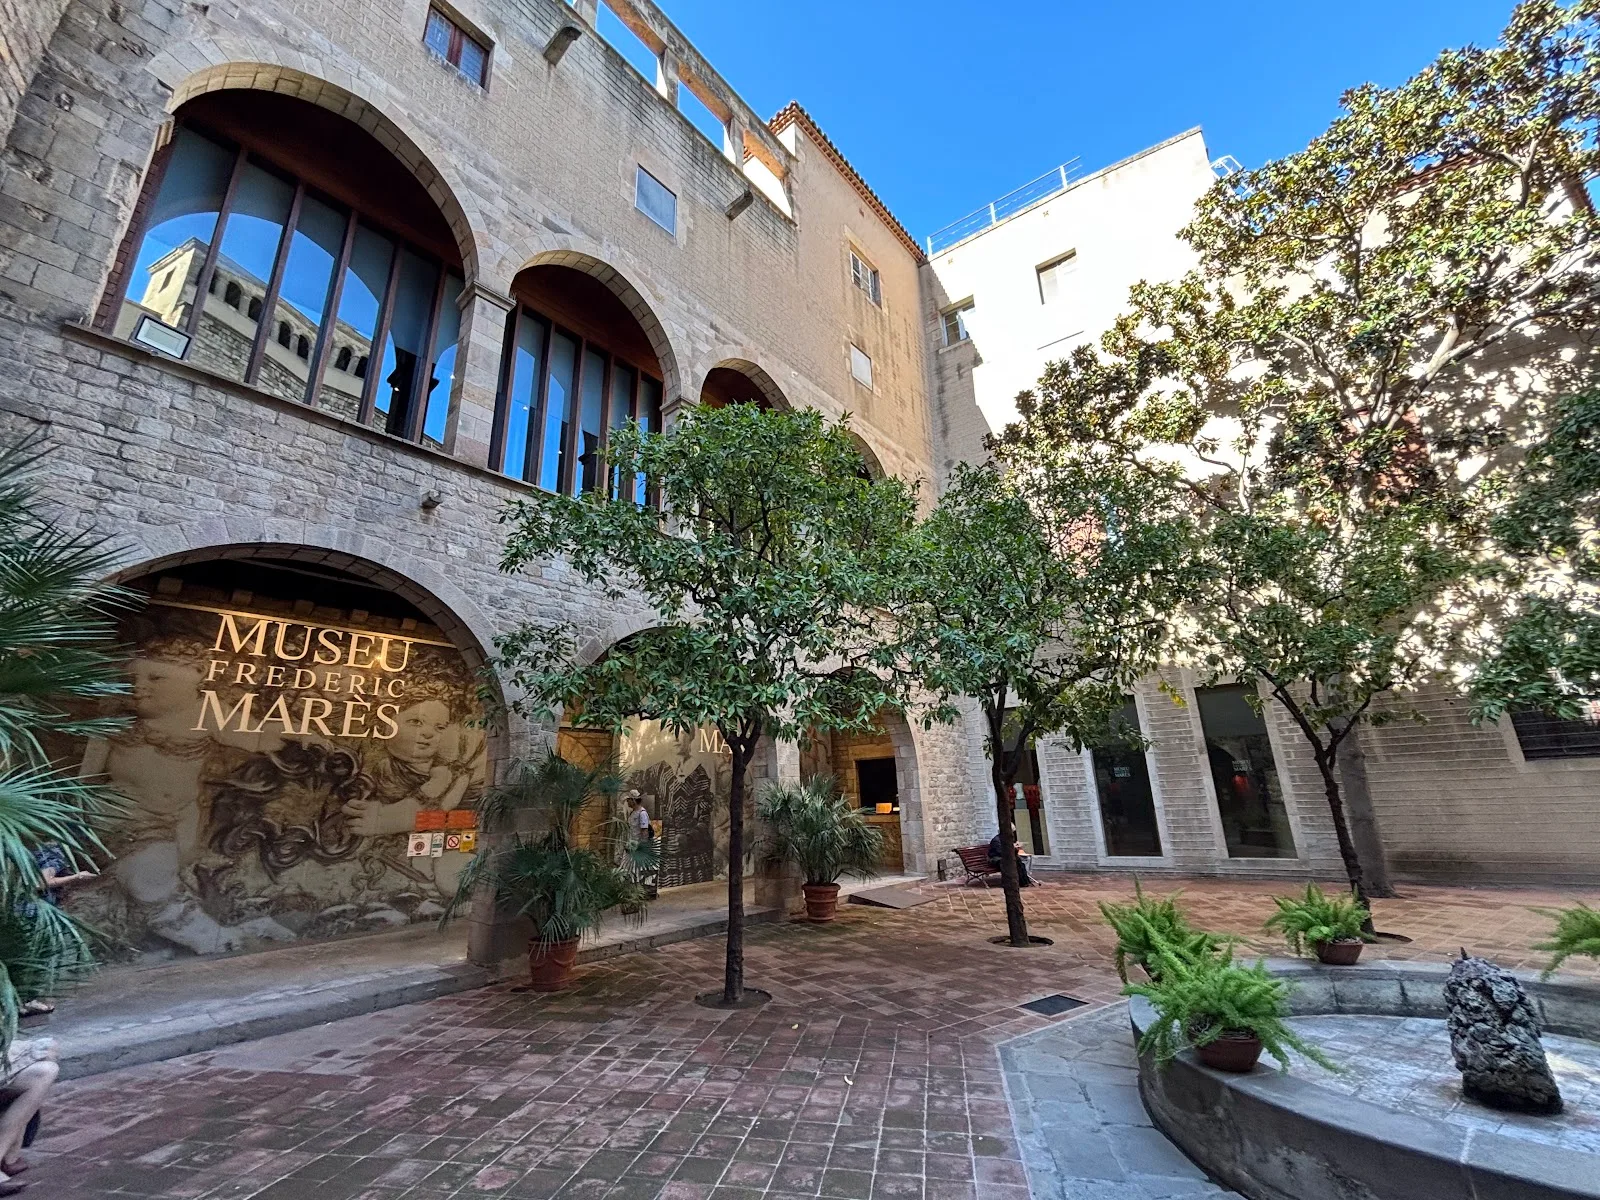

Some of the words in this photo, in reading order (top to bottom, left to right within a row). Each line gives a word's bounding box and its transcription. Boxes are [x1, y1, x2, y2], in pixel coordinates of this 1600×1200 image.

[209, 613, 413, 672] MUSEU
[205, 660, 406, 698] FREDERIC
[190, 690, 400, 739] MARÈS
[698, 728, 746, 754] MA
